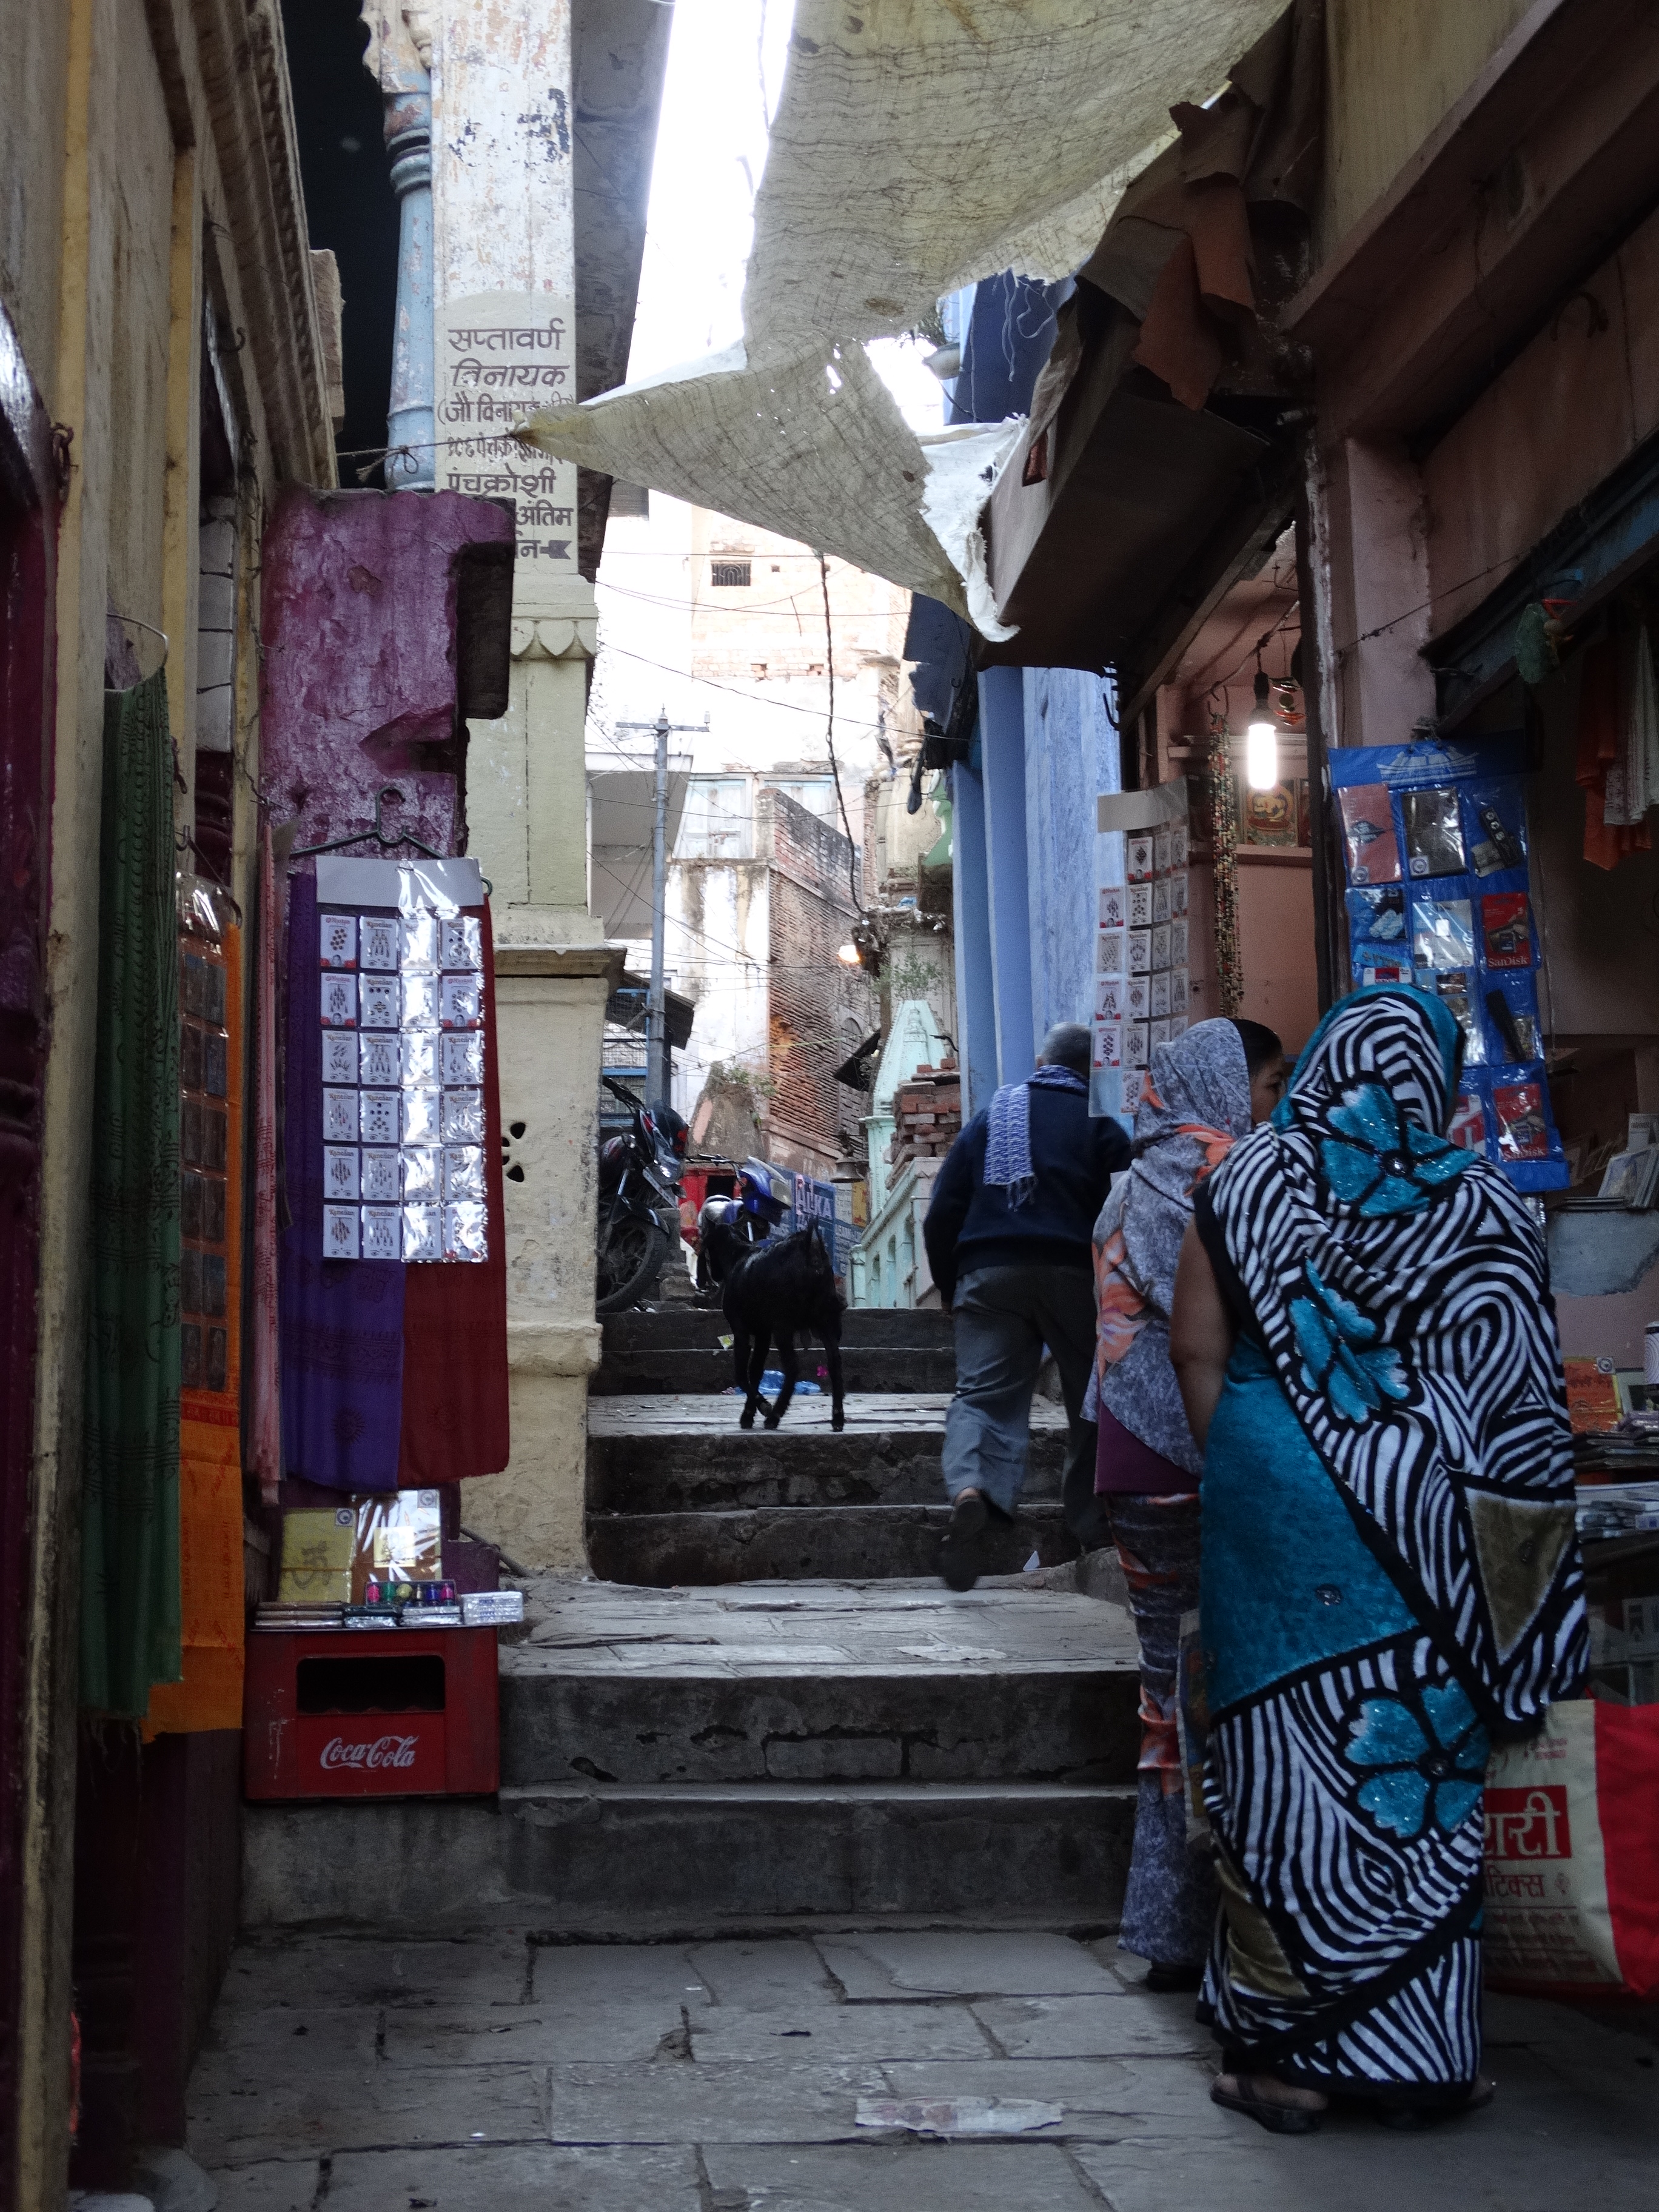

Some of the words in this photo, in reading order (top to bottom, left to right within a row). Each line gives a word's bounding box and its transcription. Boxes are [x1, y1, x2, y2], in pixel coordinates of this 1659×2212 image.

[448, 317, 566, 352] सप्तावर्ण
[447, 462, 557, 498] पंचक्रोशी
[517, 499, 574, 526] अंतिम
[1489, 954, 1529, 968] SanDisk
[320, 1735, 420, 1769] Coca-Cola
